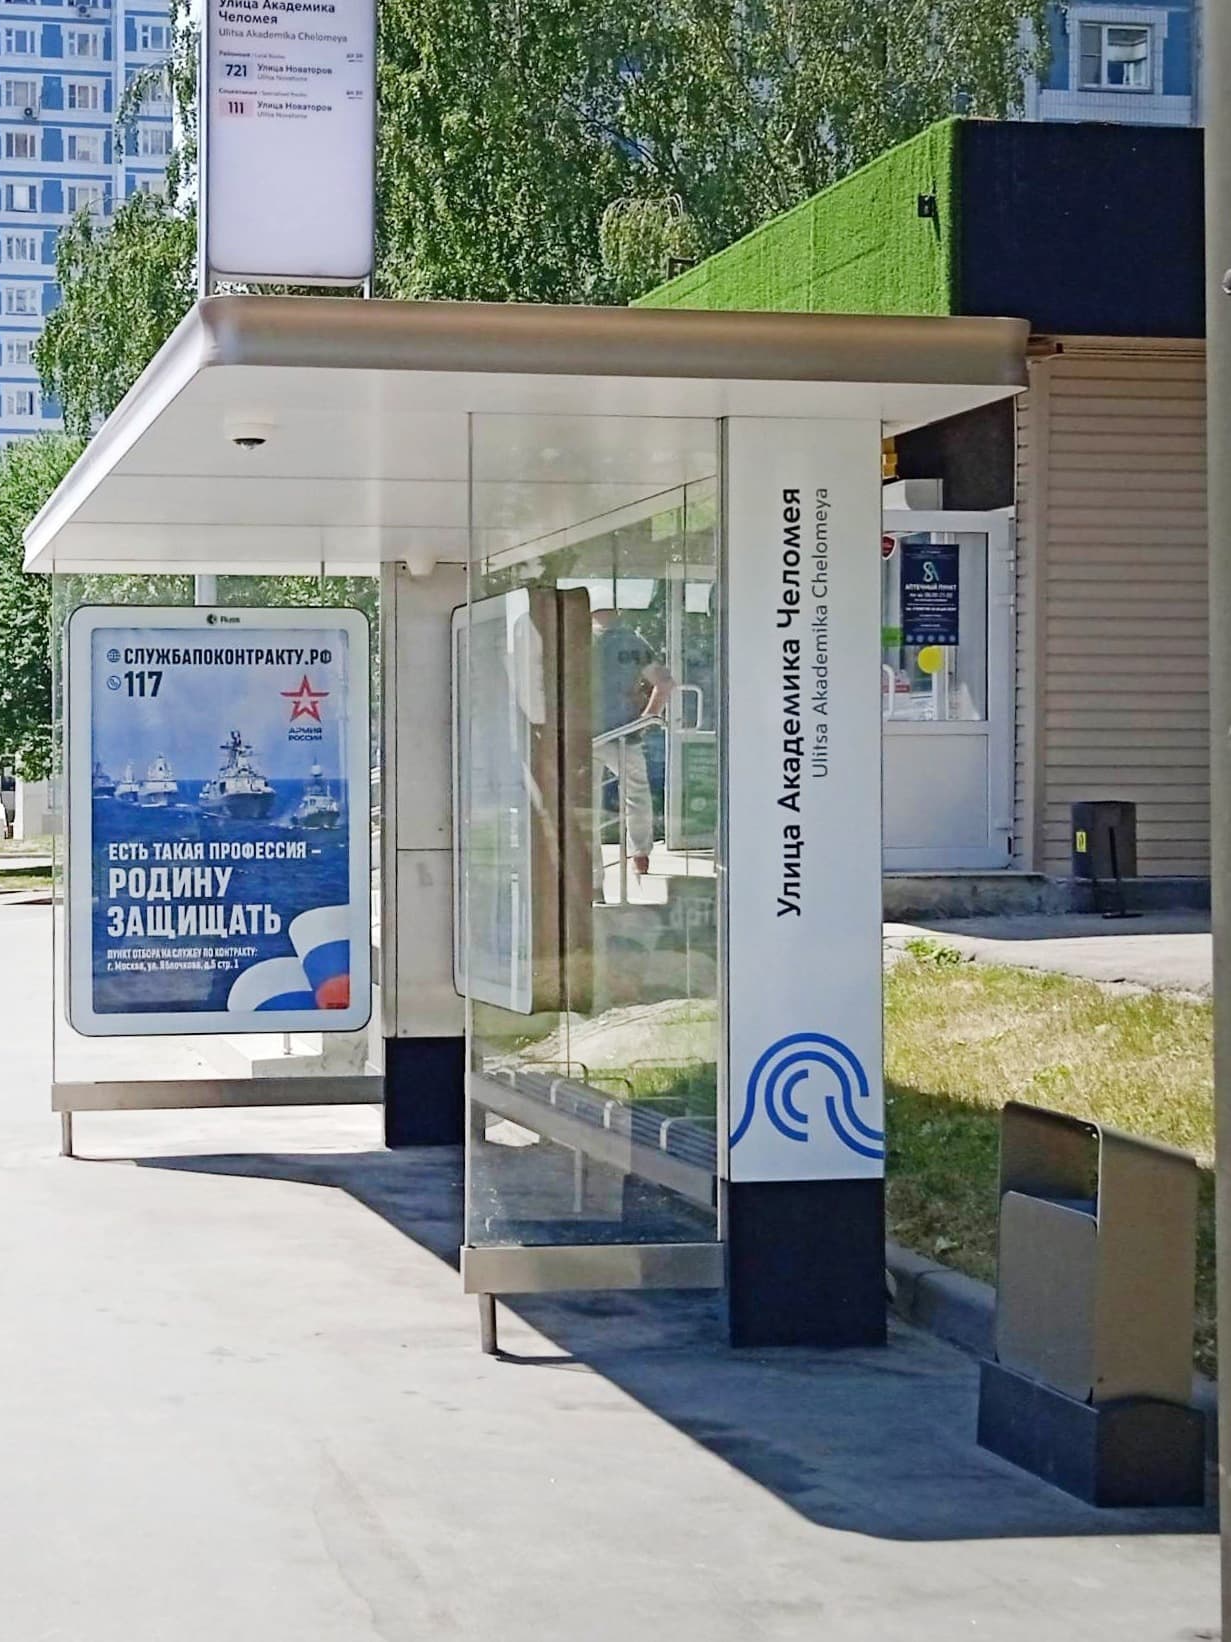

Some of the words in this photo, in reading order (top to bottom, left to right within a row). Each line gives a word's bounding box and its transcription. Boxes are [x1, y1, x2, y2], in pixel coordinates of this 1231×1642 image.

[219, 0, 259, 10] Улица
[262, 0, 335, 13] Академика
[219, 10, 278, 24] Челомея
[218, 28, 244, 38] Ulitsa
[225, 64, 247, 77] 721
[257, 63, 284, 73] Улица
[228, 101, 244, 114] 111
[257, 101, 284, 110] Улица
[811, 488, 832, 598] Chelomeya
[777, 488, 801, 628] Челомея
[124, 648, 332, 666] СЛУЖБАПОКОНТРАКТУ.РФ
[811, 604, 828, 716] Akademika
[124, 671, 163, 698] 117
[777, 638, 804, 812] Академика
[812, 722, 828, 778] Ulitsa
[109, 842, 148, 861] ЕСТЬ
[153, 842, 204, 861] ТАКАЯ
[209, 841, 307, 860] ПРОФЕССИЯ
[777, 824, 804, 917] Улица
[109, 866, 234, 901] РОДИНУ
[106, 903, 282, 939] ЗАЩИЩАТЬ
[107, 949, 131, 959] ПУНКТ
[132, 949, 161, 959] ОТБОРА
[161, 949, 172, 958] НА
[203, 948, 214, 958] ПО
